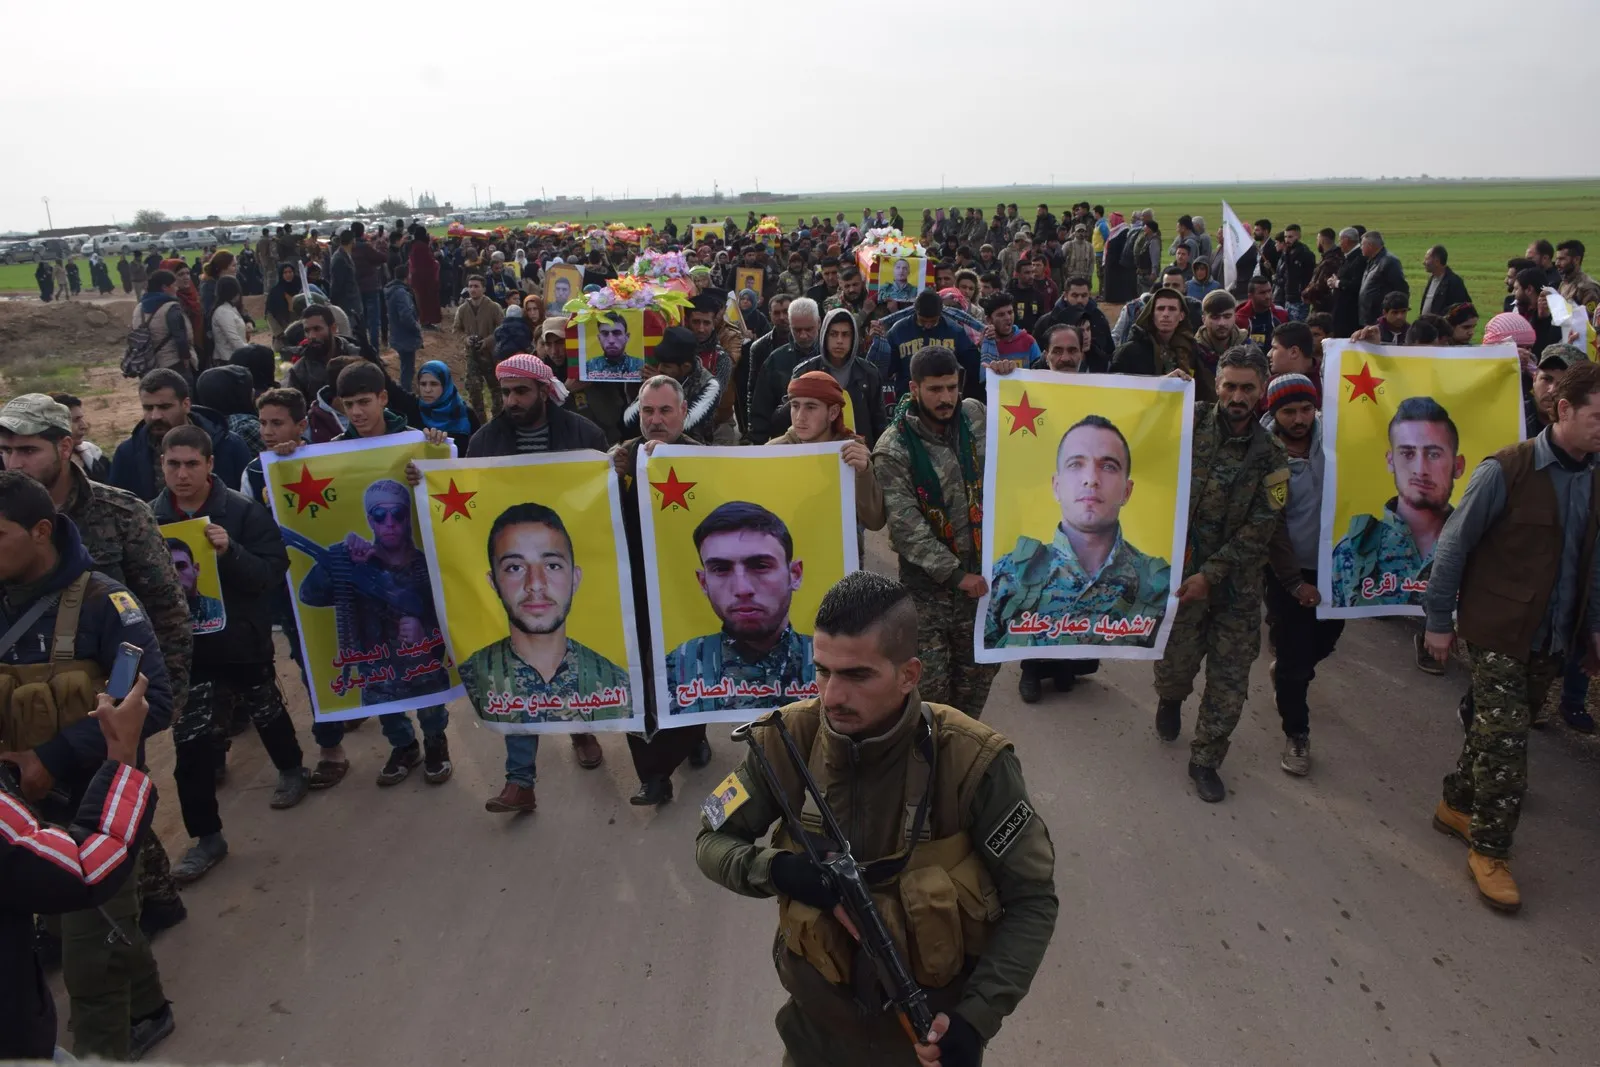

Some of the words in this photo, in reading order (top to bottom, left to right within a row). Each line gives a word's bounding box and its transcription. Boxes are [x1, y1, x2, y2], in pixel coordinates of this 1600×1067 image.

[1362, 572, 1397, 599] اقرع
[1401, 577, 1429, 593] حمد
[1009, 611, 1050, 633] خلف
[1050, 613, 1090, 638] عمار
[1094, 614, 1156, 640] الشهيد
[396, 628, 445, 657] شهيد
[332, 643, 390, 668] البطل
[330, 665, 396, 696] الديري
[402, 659, 441, 681] عمر
[569, 686, 627, 713] الشهيد
[677, 677, 733, 706] الصالح
[737, 679, 780, 698] احمد
[786, 681, 819, 699] هيد
[487, 691, 524, 715] عزيز
[527, 693, 562, 715] عدي
[1013, 804, 1029, 826] قوات
[991, 822, 1017, 850] العمليات
